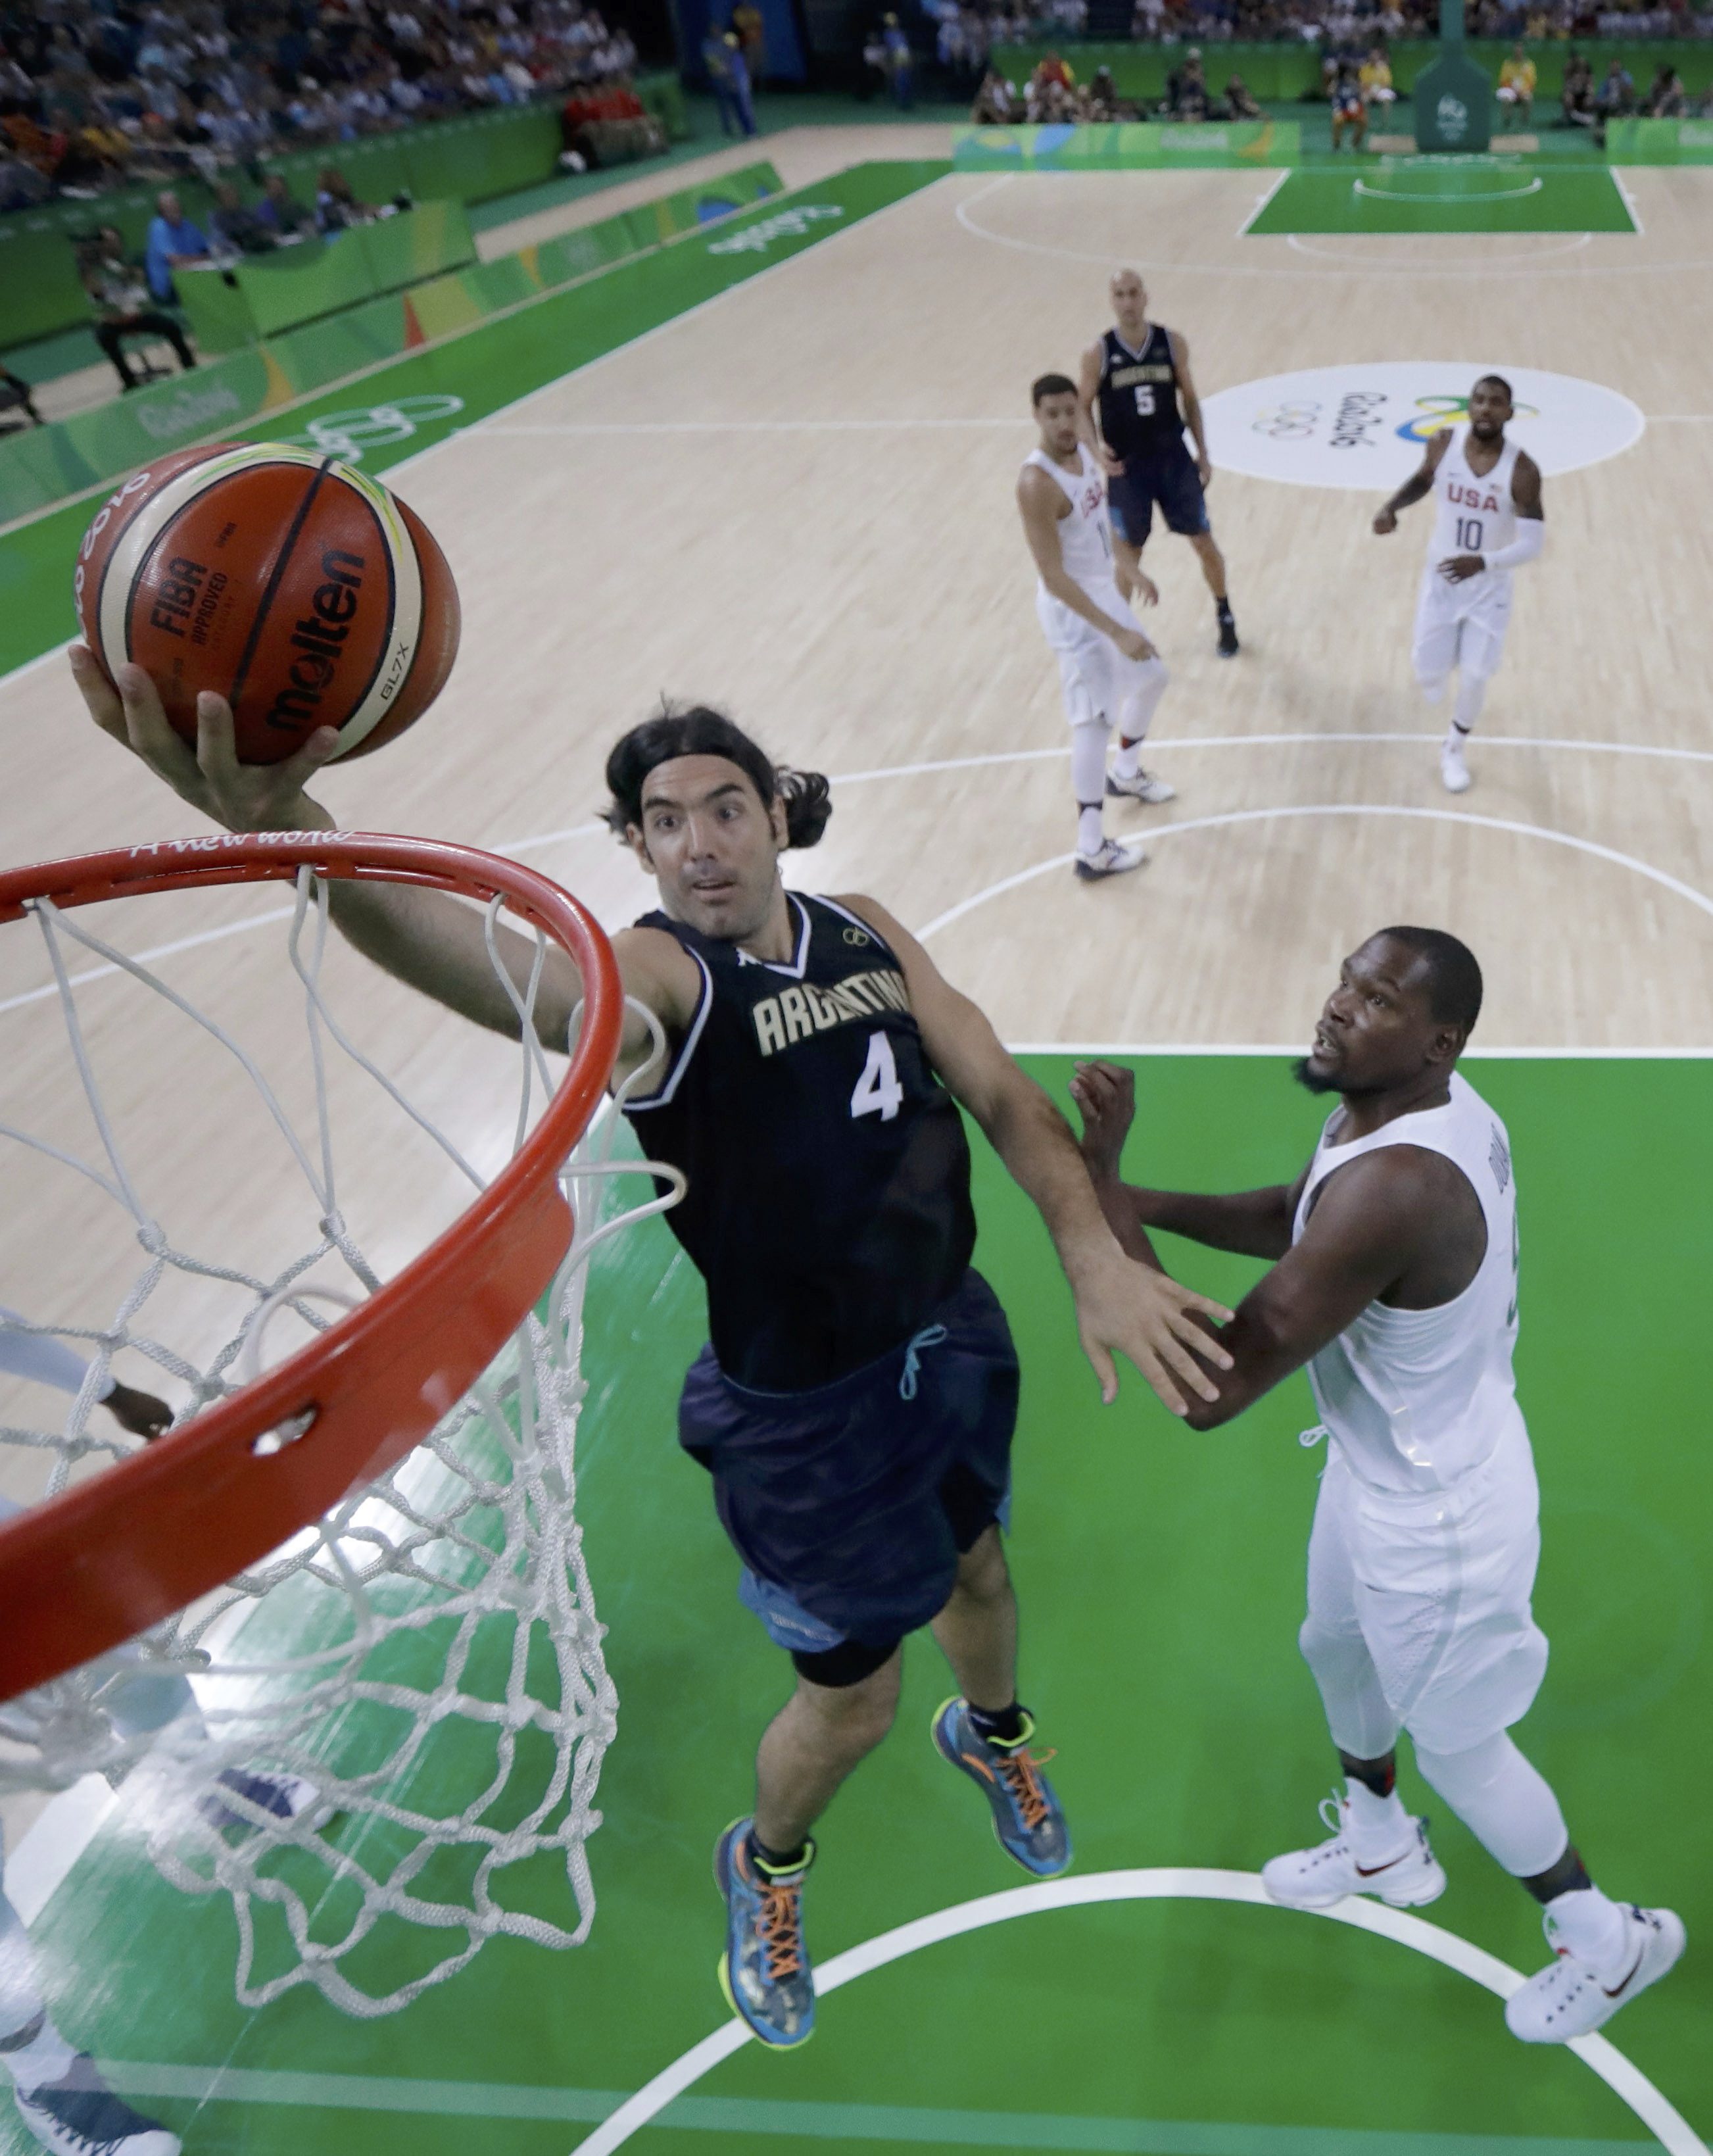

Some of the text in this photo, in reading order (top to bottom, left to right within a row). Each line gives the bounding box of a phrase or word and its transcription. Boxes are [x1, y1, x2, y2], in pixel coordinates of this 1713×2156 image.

[1134, 385, 1155, 416] 5
[1448, 483, 1499, 513] USA
[1456, 517, 1483, 551] 10
[151, 557, 207, 639] FIBA
[193, 572, 228, 645] APPROVED
[266, 550, 364, 730] molten
[381, 642, 409, 700] GL7X
[752, 969, 910, 1057] ARGNTIN
[850, 1030, 904, 1122] 4
